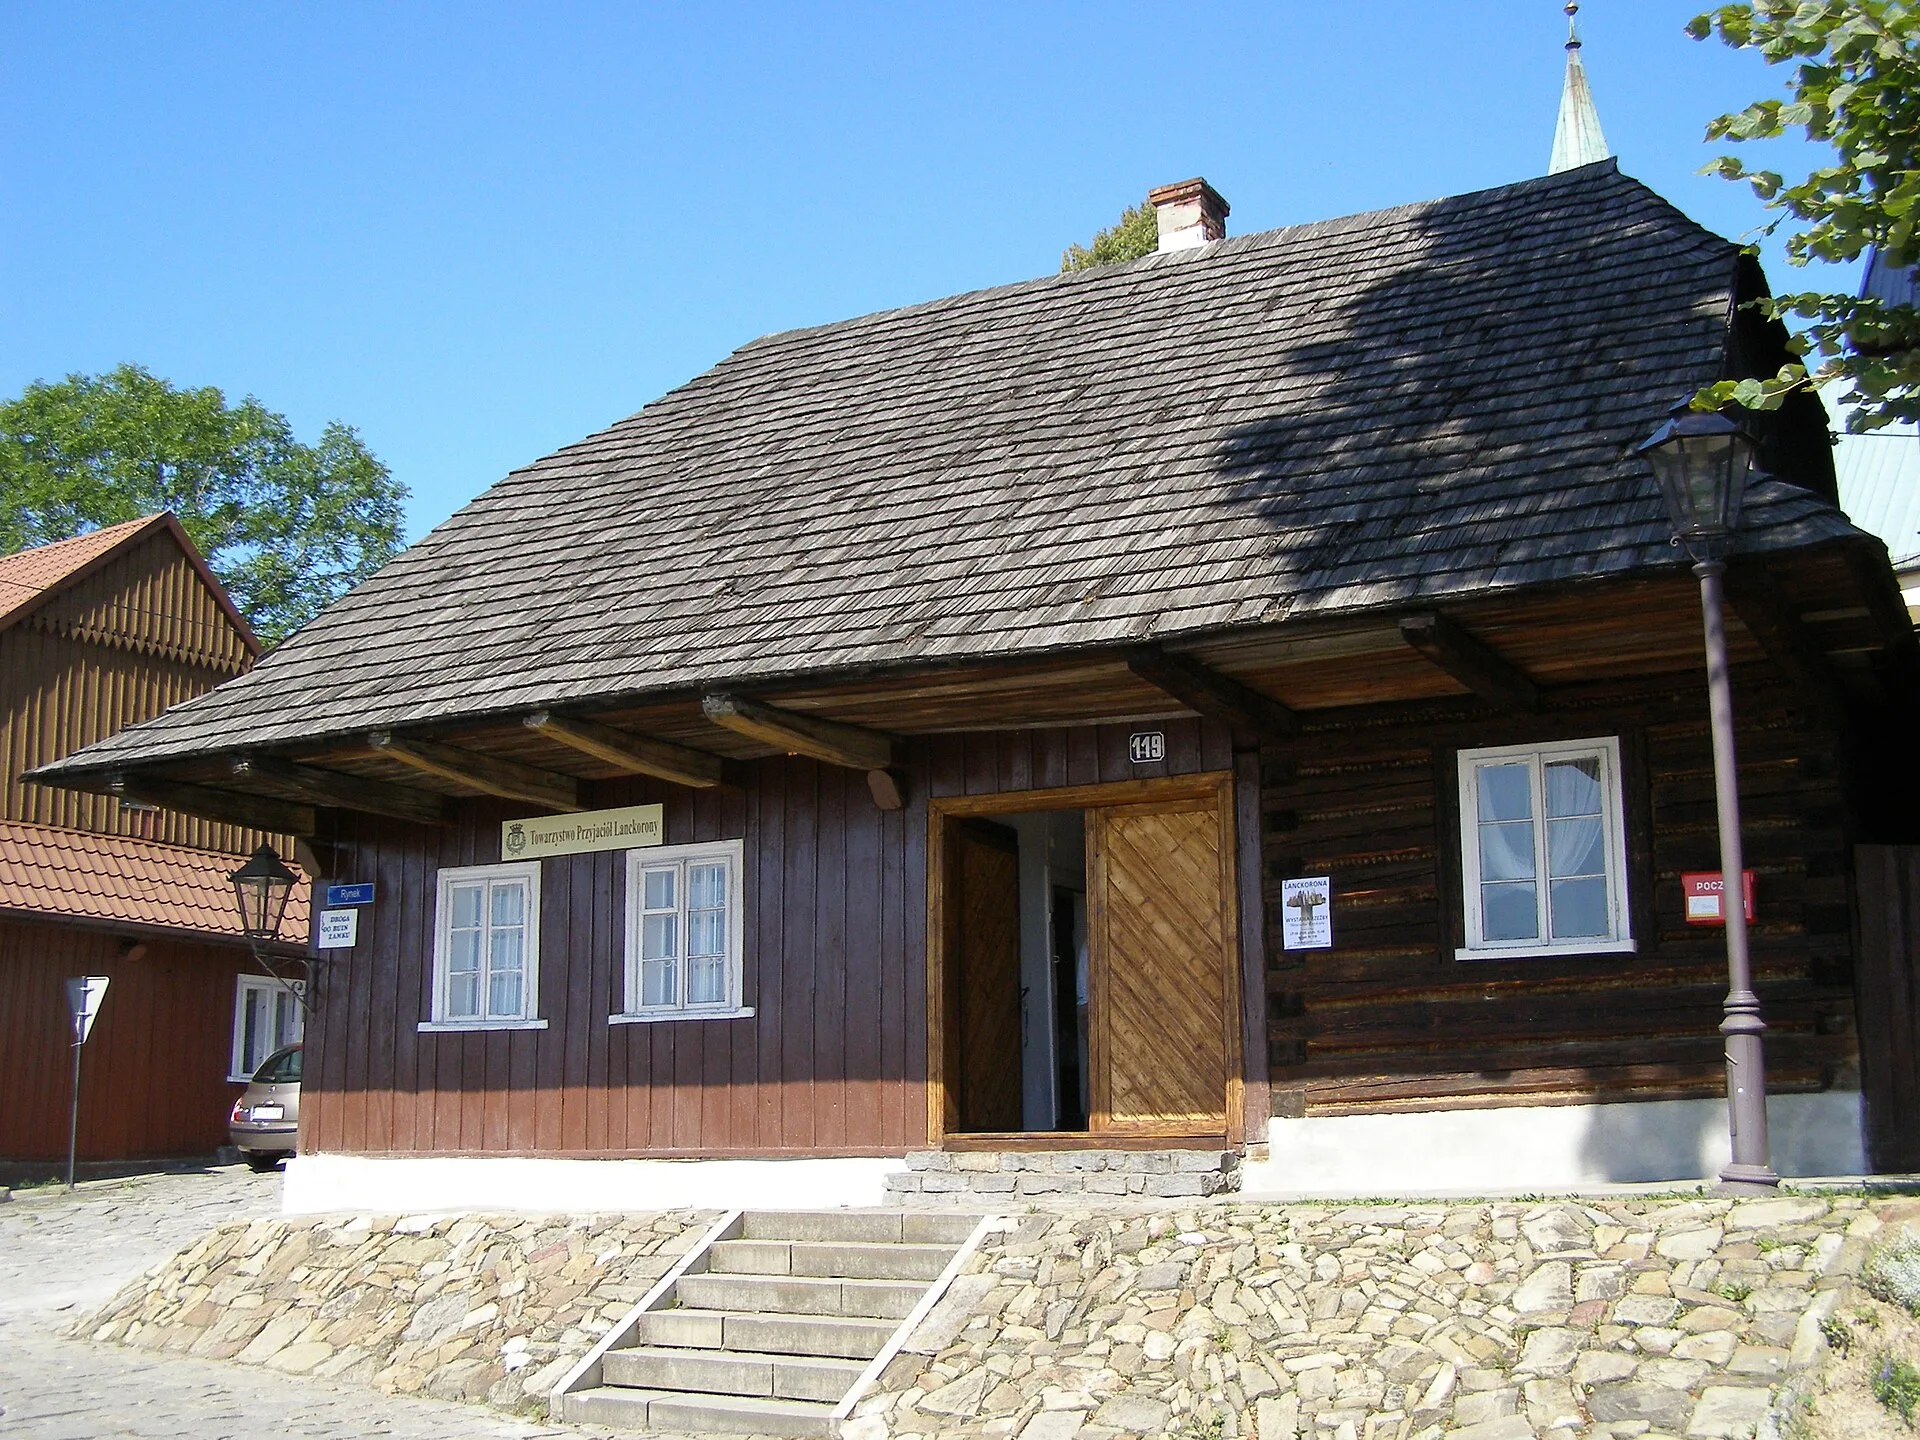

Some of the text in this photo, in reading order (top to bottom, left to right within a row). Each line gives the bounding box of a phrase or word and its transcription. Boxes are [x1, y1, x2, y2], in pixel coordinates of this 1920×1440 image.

[1132, 736, 1161, 758] 119
[531, 819, 658, 846] Towarzystwo Przyjaciół Lanckorony
[1285, 881, 1327, 889] LANCKORONA
[1696, 881, 1724, 890] POCZ
[341, 889, 360, 900] Rynek
